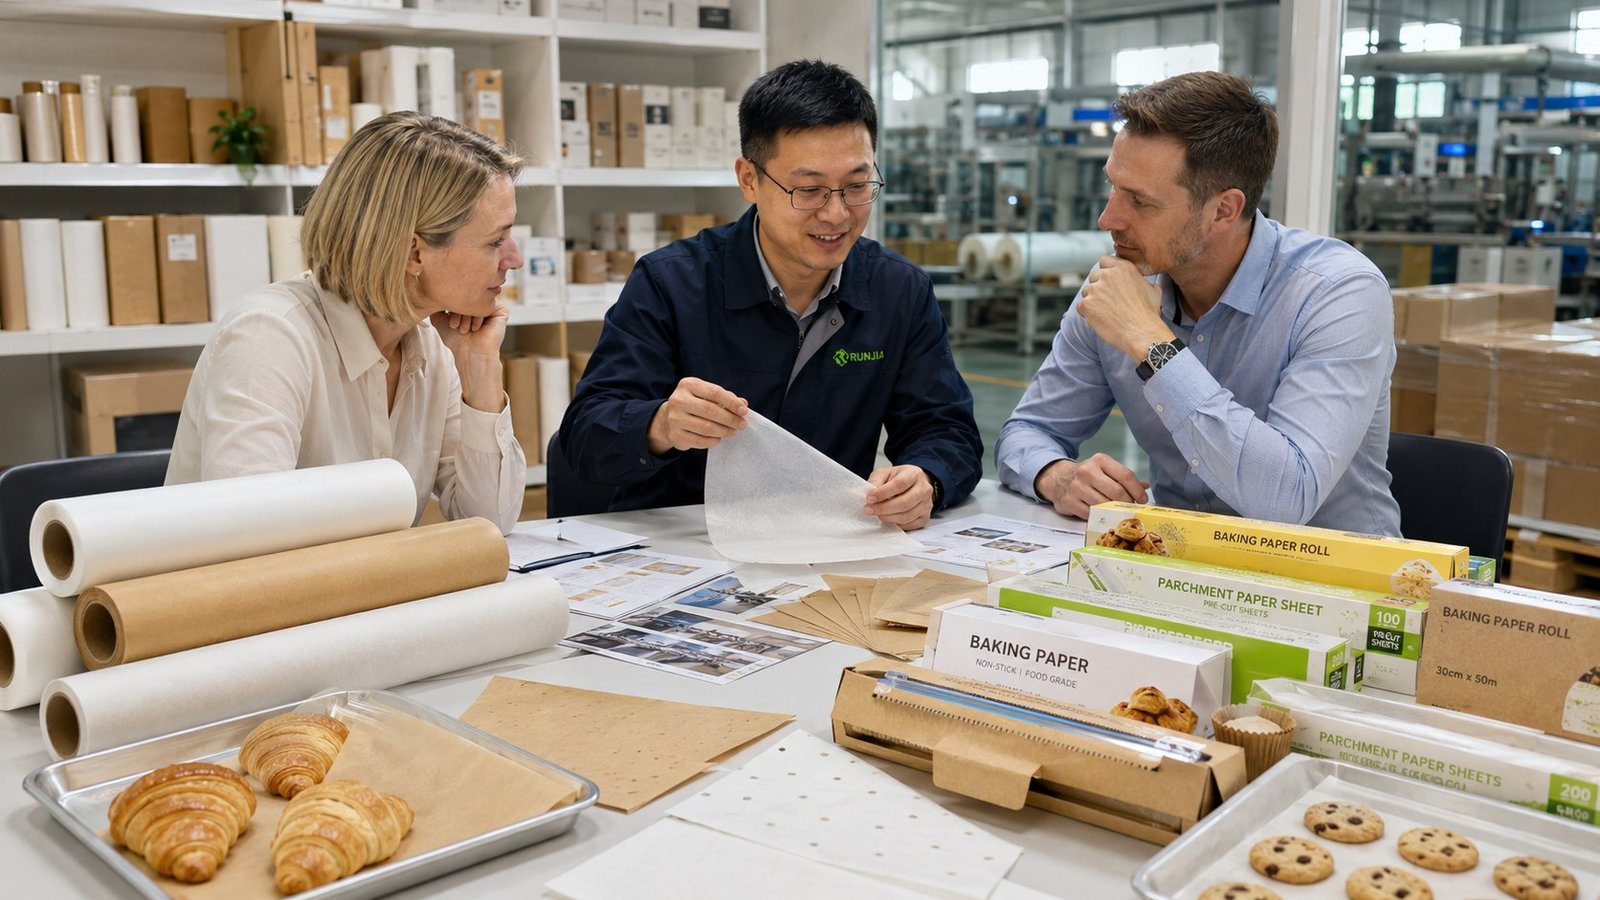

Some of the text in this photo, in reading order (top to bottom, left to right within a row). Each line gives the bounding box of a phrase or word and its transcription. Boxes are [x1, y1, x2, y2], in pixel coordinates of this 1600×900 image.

[850, 351, 884, 361] RUNJIA
[1214, 531, 1257, 546] BAKING
[1260, 538, 1297, 551] PAPER
[1300, 543, 1330, 556] ROLL
[1158, 577, 1323, 616] PARCHMENT PAPER SHEET
[1239, 606, 1268, 618] SHEETS
[1377, 611, 1400, 625] 100
[1443, 606, 1571, 640] BAKING PAPER ROLL
[970, 634, 1089, 673] BAKING PAPER
[975, 659, 1017, 674] NON-STICK
[1025, 669, 1048, 681] FOOD
[1049, 675, 1077, 688] GRADE
[1436, 665, 1463, 680] 30cm
[1475, 674, 1498, 687] 50m
[1319, 731, 1399, 760] PARCHMENT
[1402, 752, 1445, 773] PAPER
[1448, 764, 1502, 787] SHEETS
[1560, 783, 1591, 801] 200
